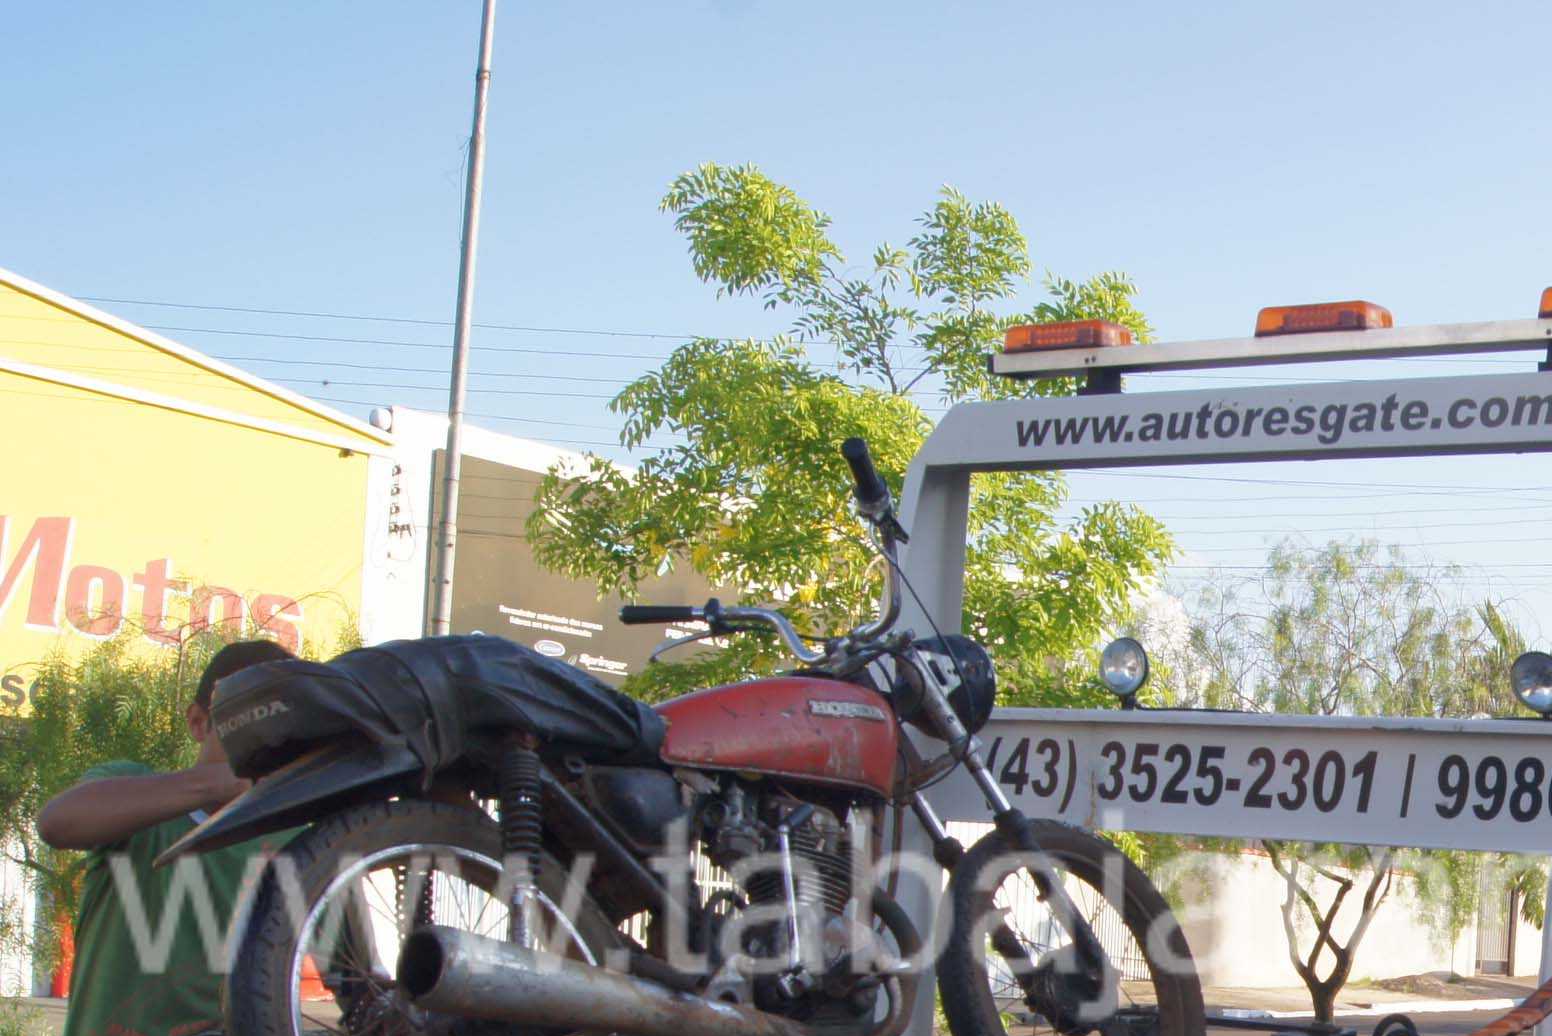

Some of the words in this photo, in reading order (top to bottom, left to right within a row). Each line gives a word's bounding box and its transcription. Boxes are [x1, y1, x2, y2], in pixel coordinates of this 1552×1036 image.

[217, 701, 290, 739] HONDA
[986, 736, 1078, 814] (43)
[1097, 741, 1378, 813] 3525-2301
